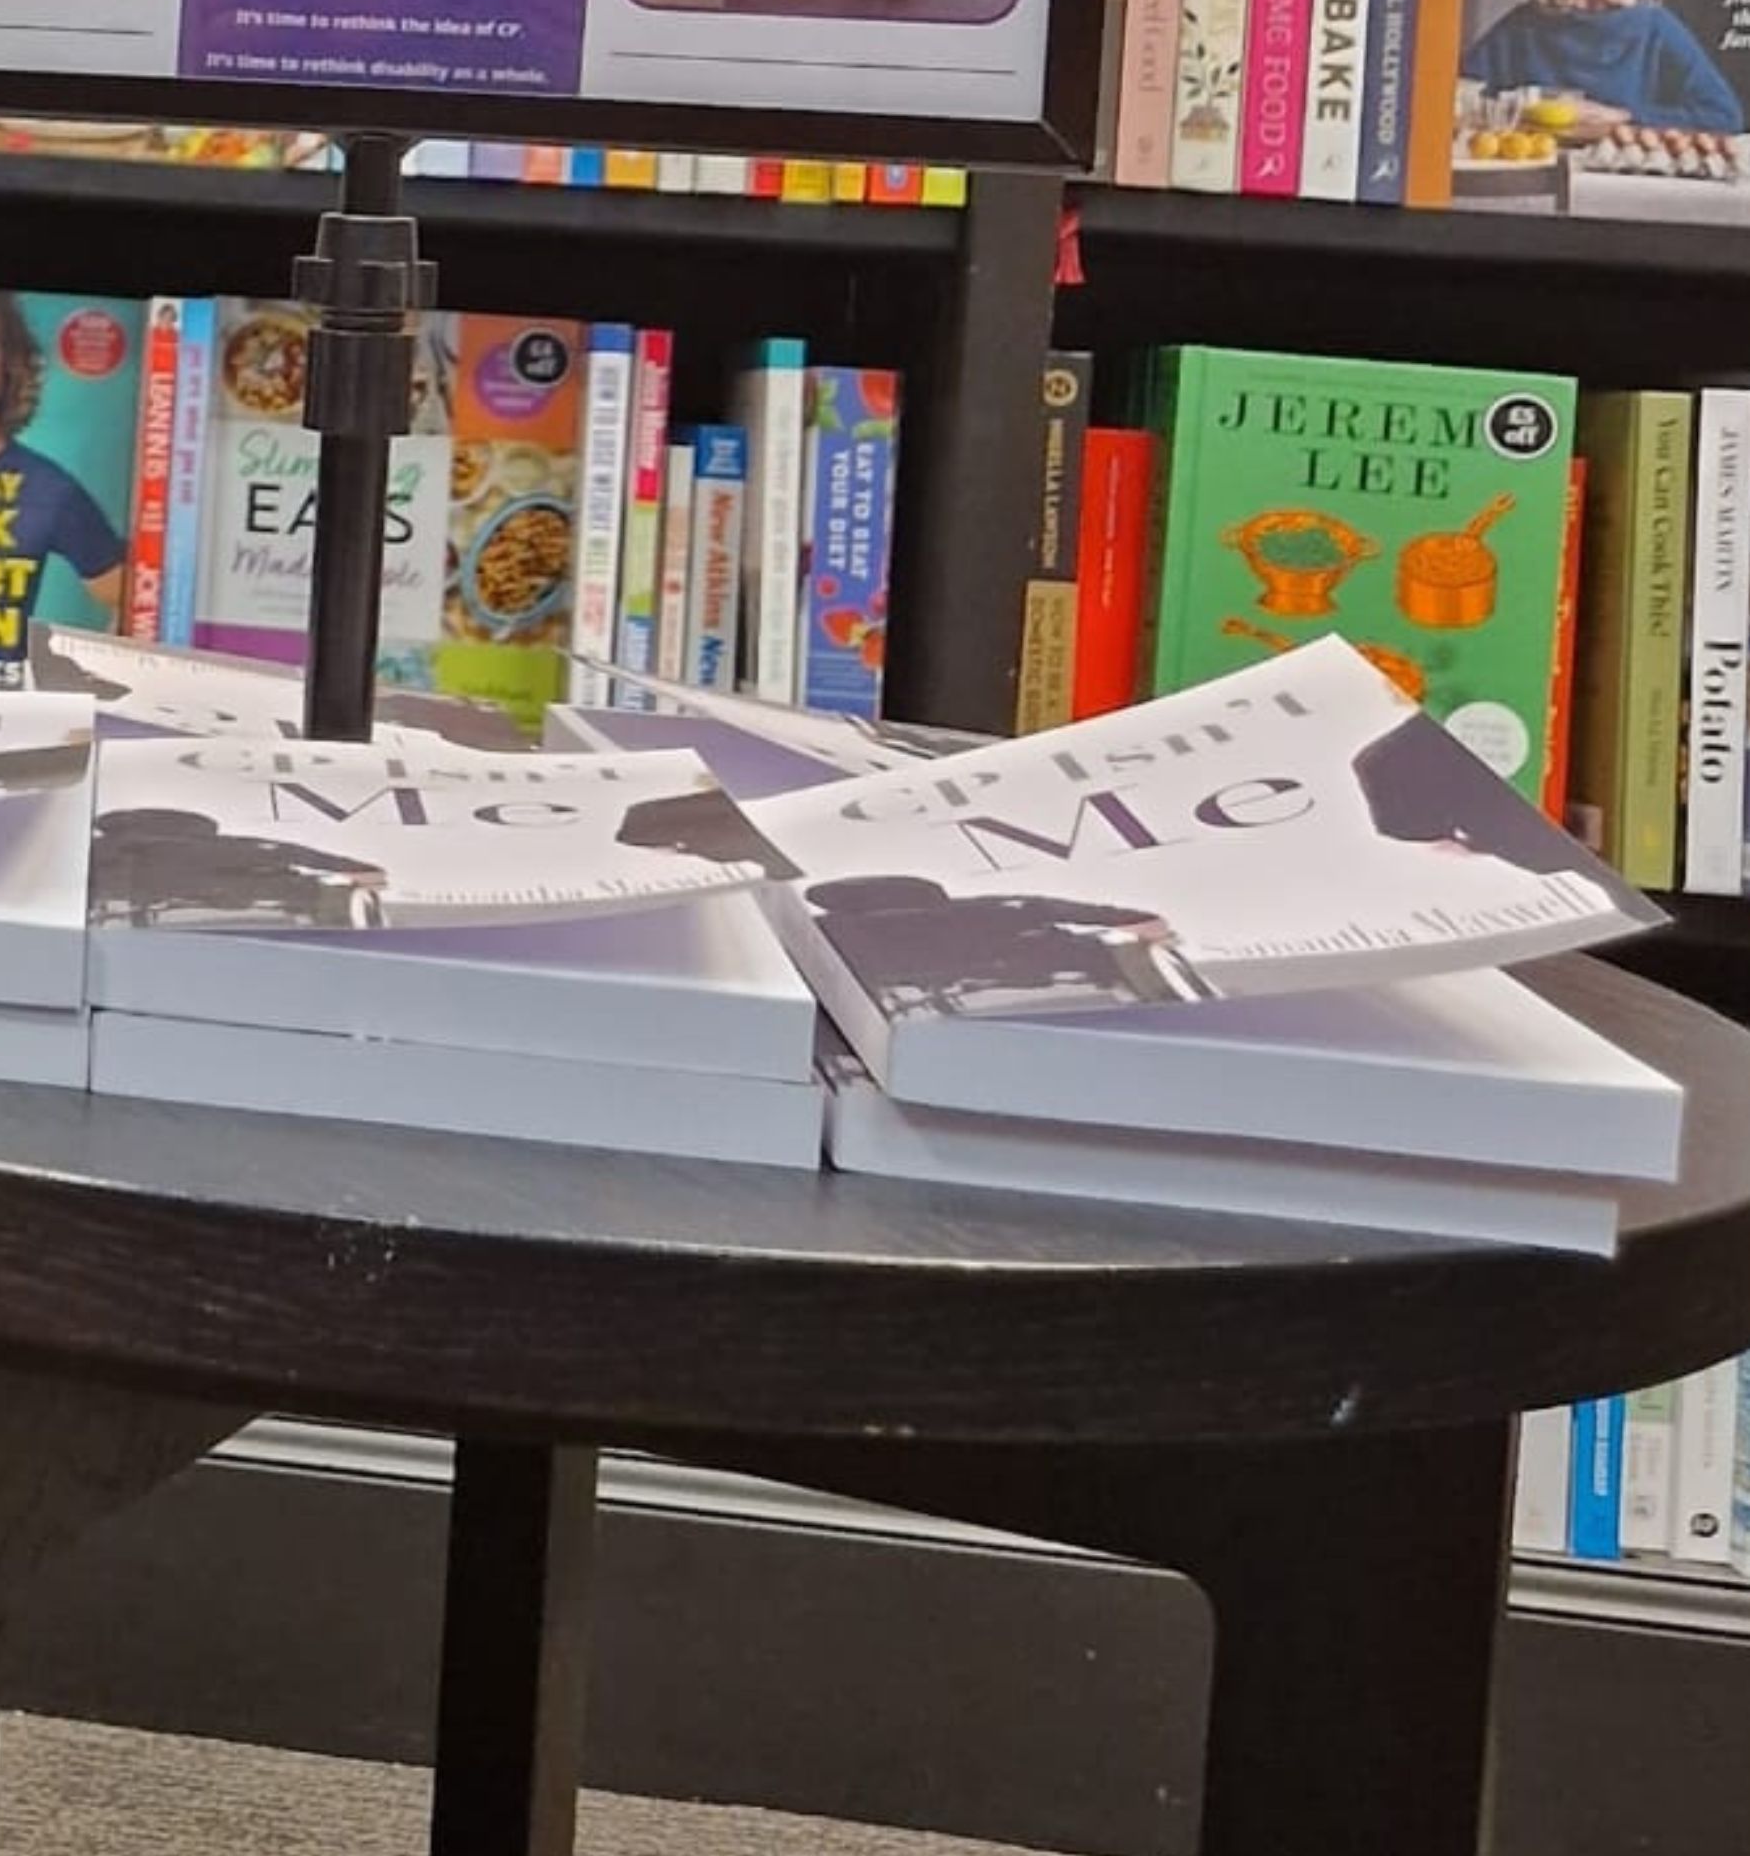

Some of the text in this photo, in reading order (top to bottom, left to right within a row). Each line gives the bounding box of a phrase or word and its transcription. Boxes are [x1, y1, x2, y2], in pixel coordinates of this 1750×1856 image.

[1260, 53, 1290, 147] FOOD
[1218, 389, 1485, 451] JEREM
[1502, 424, 1541, 446] off
[826, 450, 849, 571] YOUR DIET
[849, 442, 874, 580] EAT TO BEAT
[1301, 450, 1452, 501] LEE
[1714, 426, 1741, 594] JAMES MARTIN
[840, 687, 1316, 827] CP Isn't
[1698, 638, 1744, 787] Potato
[269, 780, 581, 829] Me
[957, 774, 1316, 874] Me
[1420, 866, 1596, 945] Maxwell
